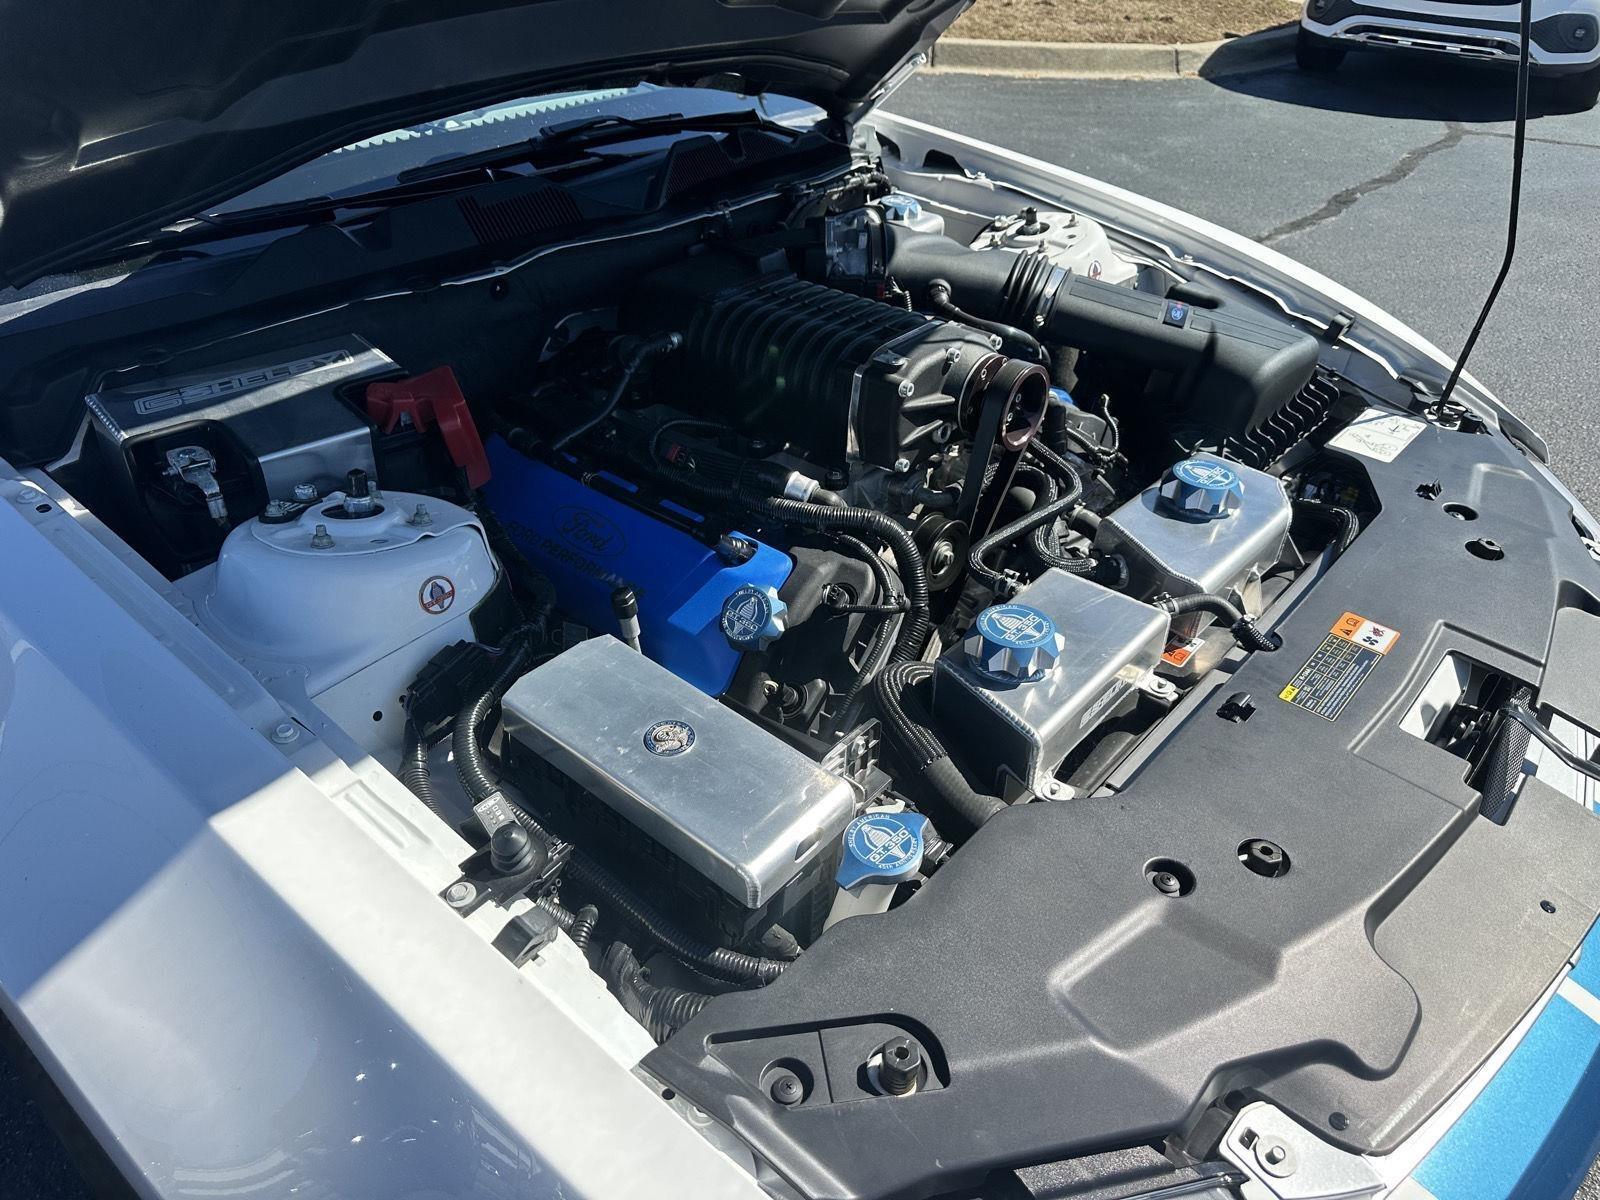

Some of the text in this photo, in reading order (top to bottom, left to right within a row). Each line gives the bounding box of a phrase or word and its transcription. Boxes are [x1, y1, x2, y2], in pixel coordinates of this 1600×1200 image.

[181, 349, 355, 405] SHELBY
[560, 510, 611, 551] Ford
[1019, 615, 1039, 631] 350
[847, 813, 890, 847] SHELBY AMERICAN
[884, 829, 909, 850] 350
